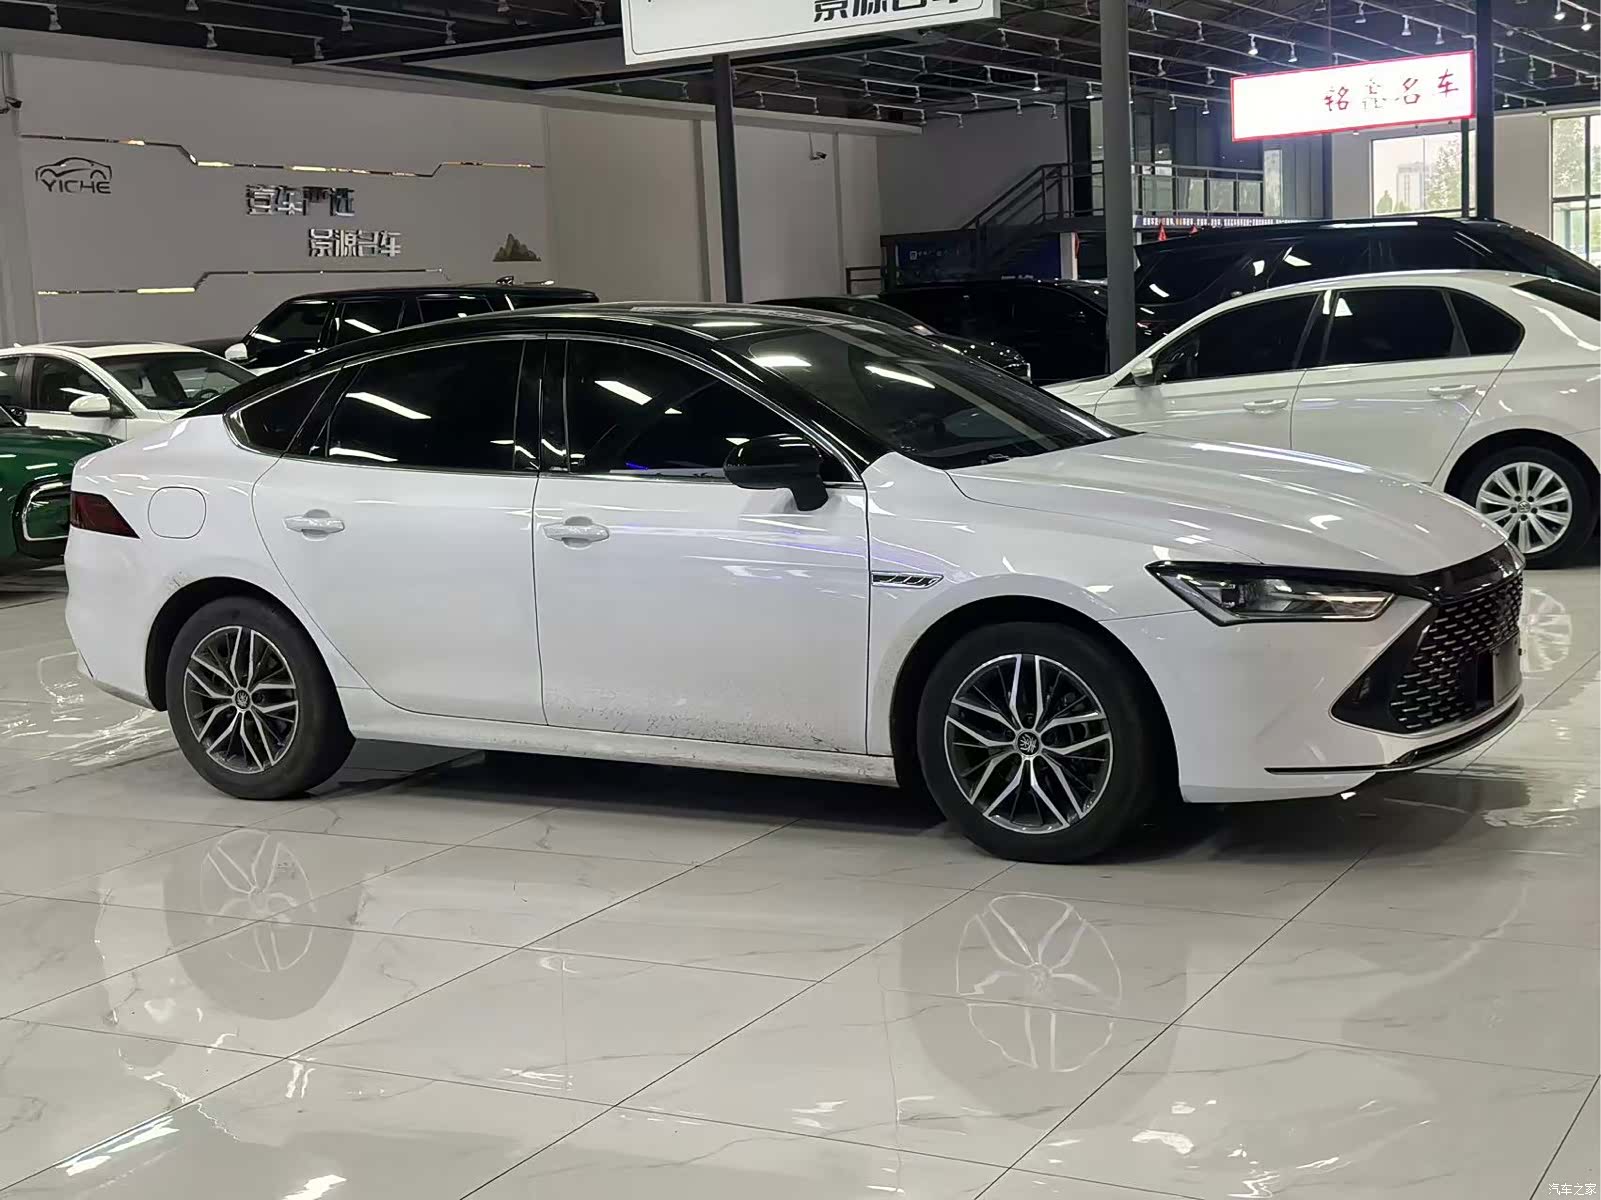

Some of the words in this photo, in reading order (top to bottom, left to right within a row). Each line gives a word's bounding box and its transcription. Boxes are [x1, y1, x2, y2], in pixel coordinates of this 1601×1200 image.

[41, 179, 111, 194] YICHE
[308, 228, 401, 257] 景源名车
